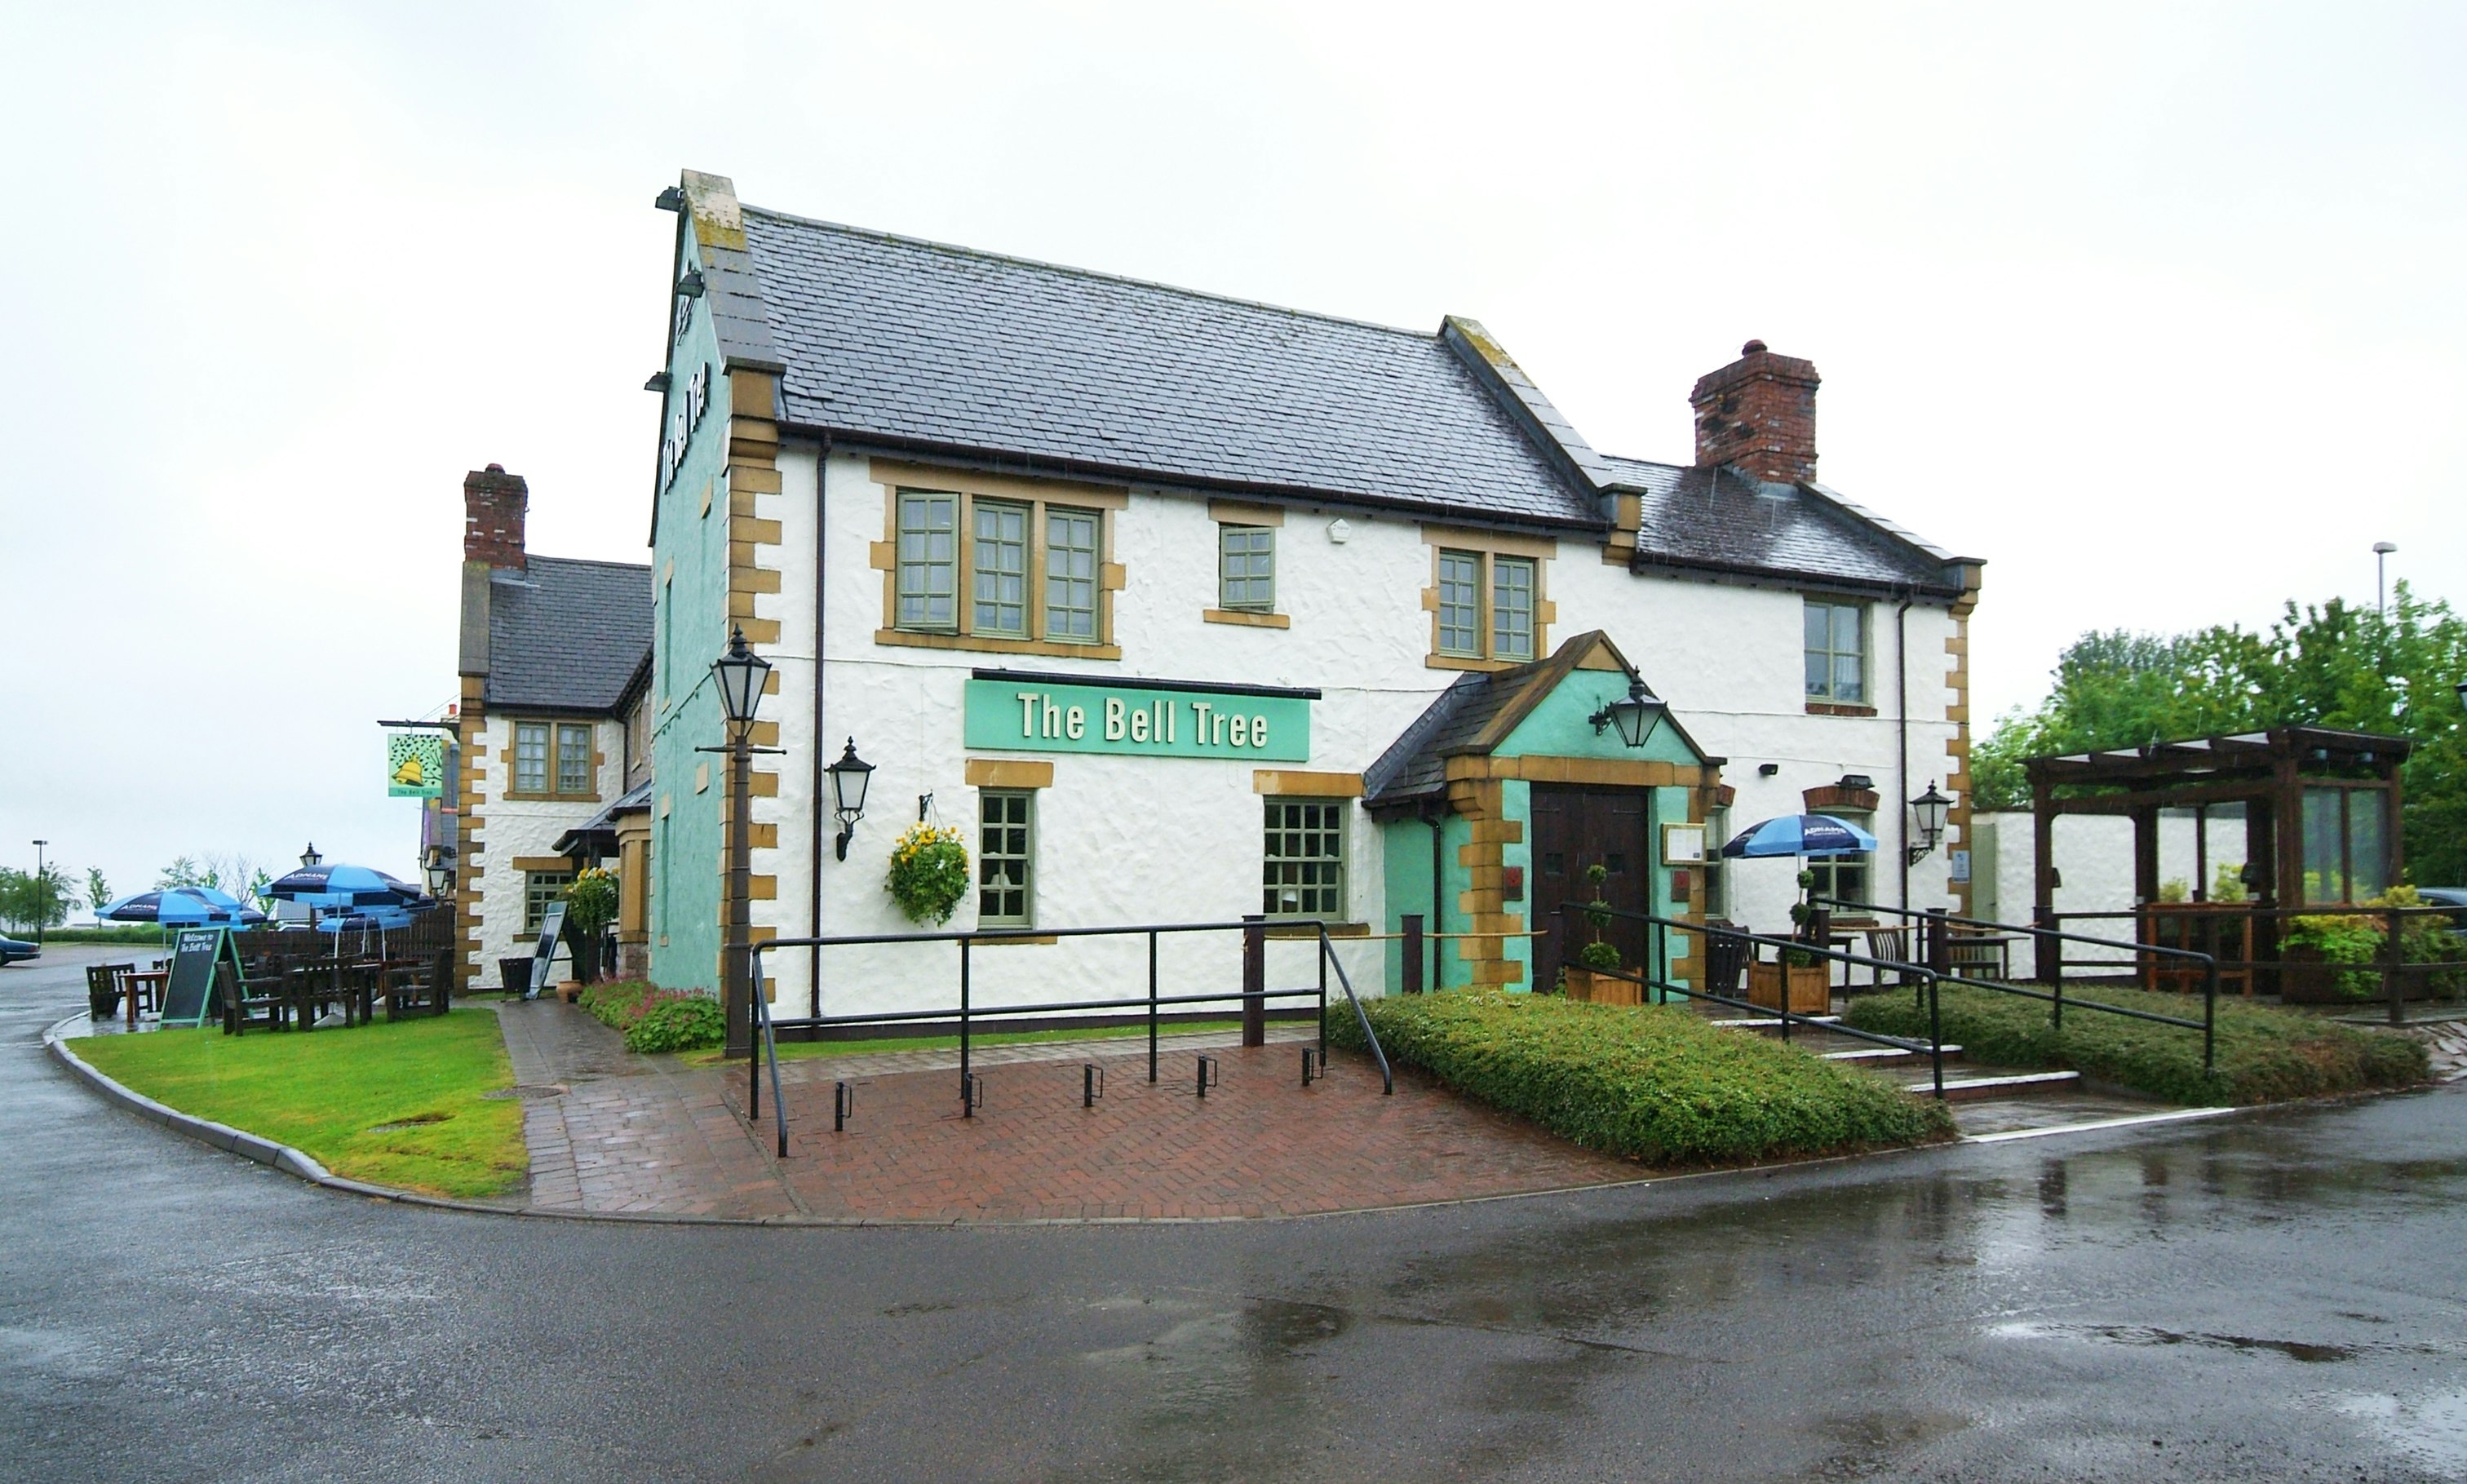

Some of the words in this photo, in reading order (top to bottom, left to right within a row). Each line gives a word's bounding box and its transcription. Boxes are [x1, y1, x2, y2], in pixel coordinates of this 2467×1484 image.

[1017, 692, 1084, 740] The
[1105, 697, 1175, 743] Bell
[1192, 702, 1268, 747] Tree
[1804, 826, 1847, 836] ADNAMS
